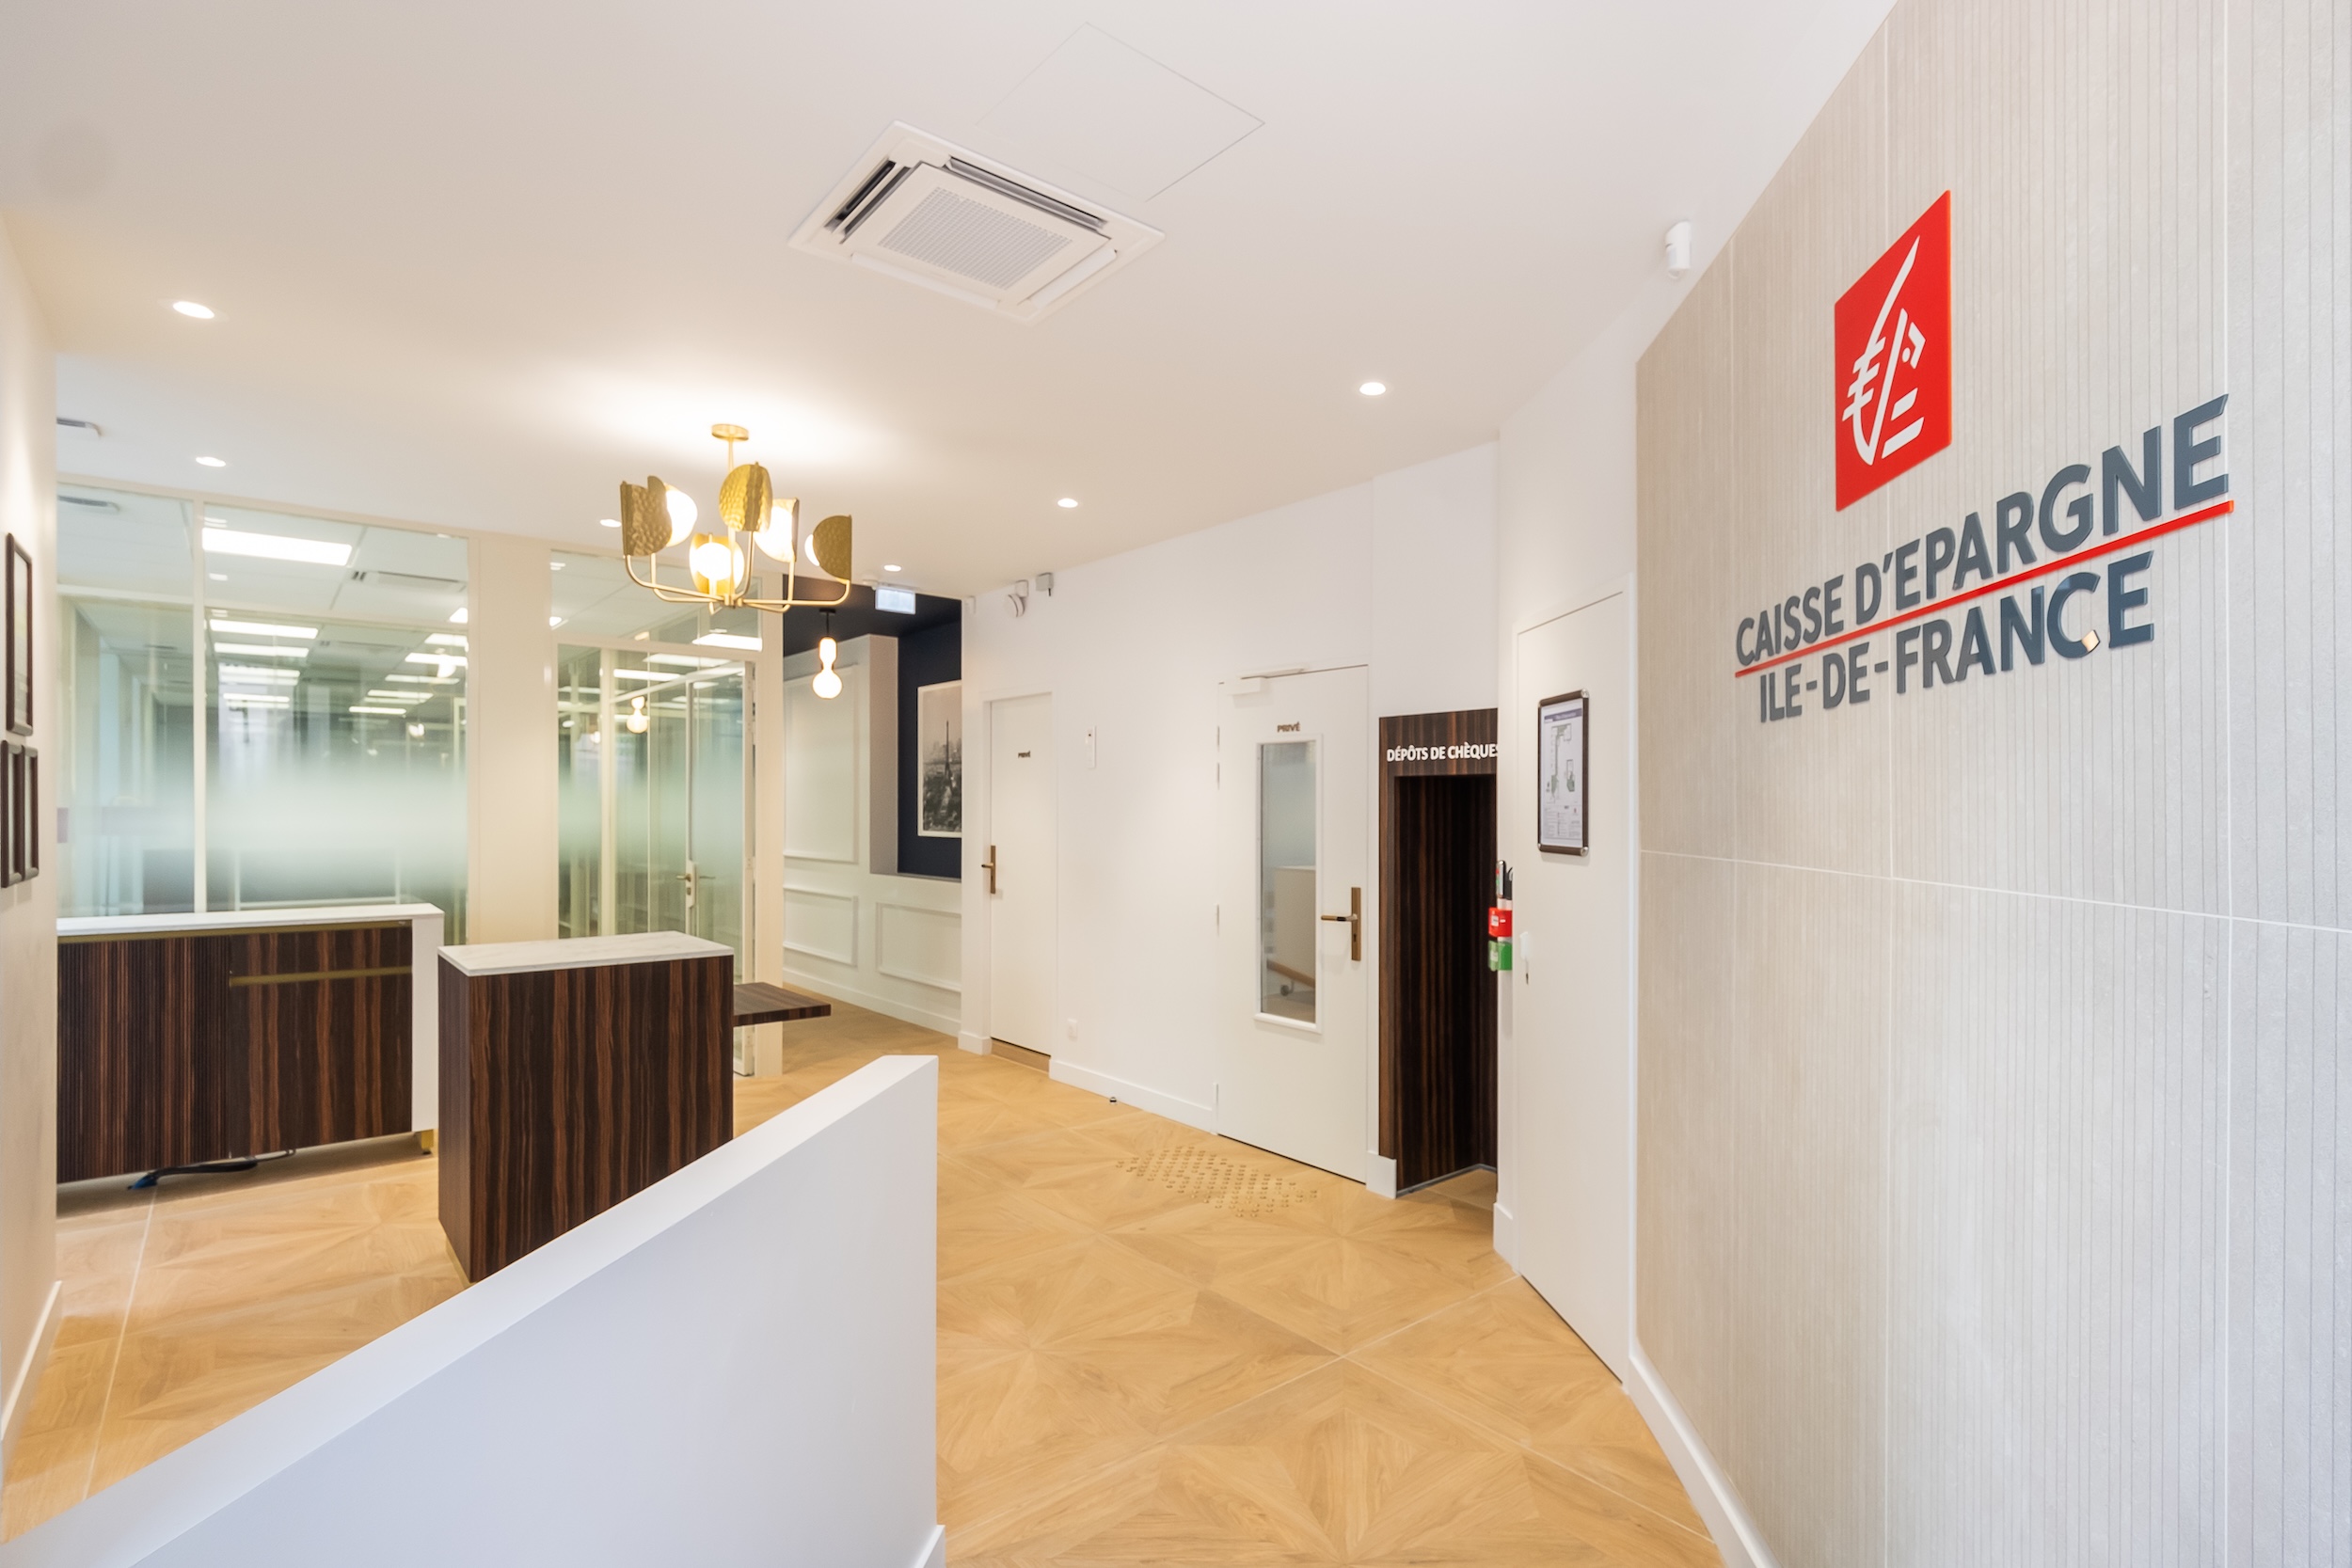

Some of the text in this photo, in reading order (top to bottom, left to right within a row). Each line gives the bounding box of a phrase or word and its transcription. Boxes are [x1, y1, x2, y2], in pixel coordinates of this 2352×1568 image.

[1736, 393, 2229, 667] CAISSE D'EPARGNE
[1759, 549, 2154, 723] ILE-DE-FRANCE
[1386, 744, 1428, 762] DÉPÔTS
[1430, 746, 1446, 760] DE
